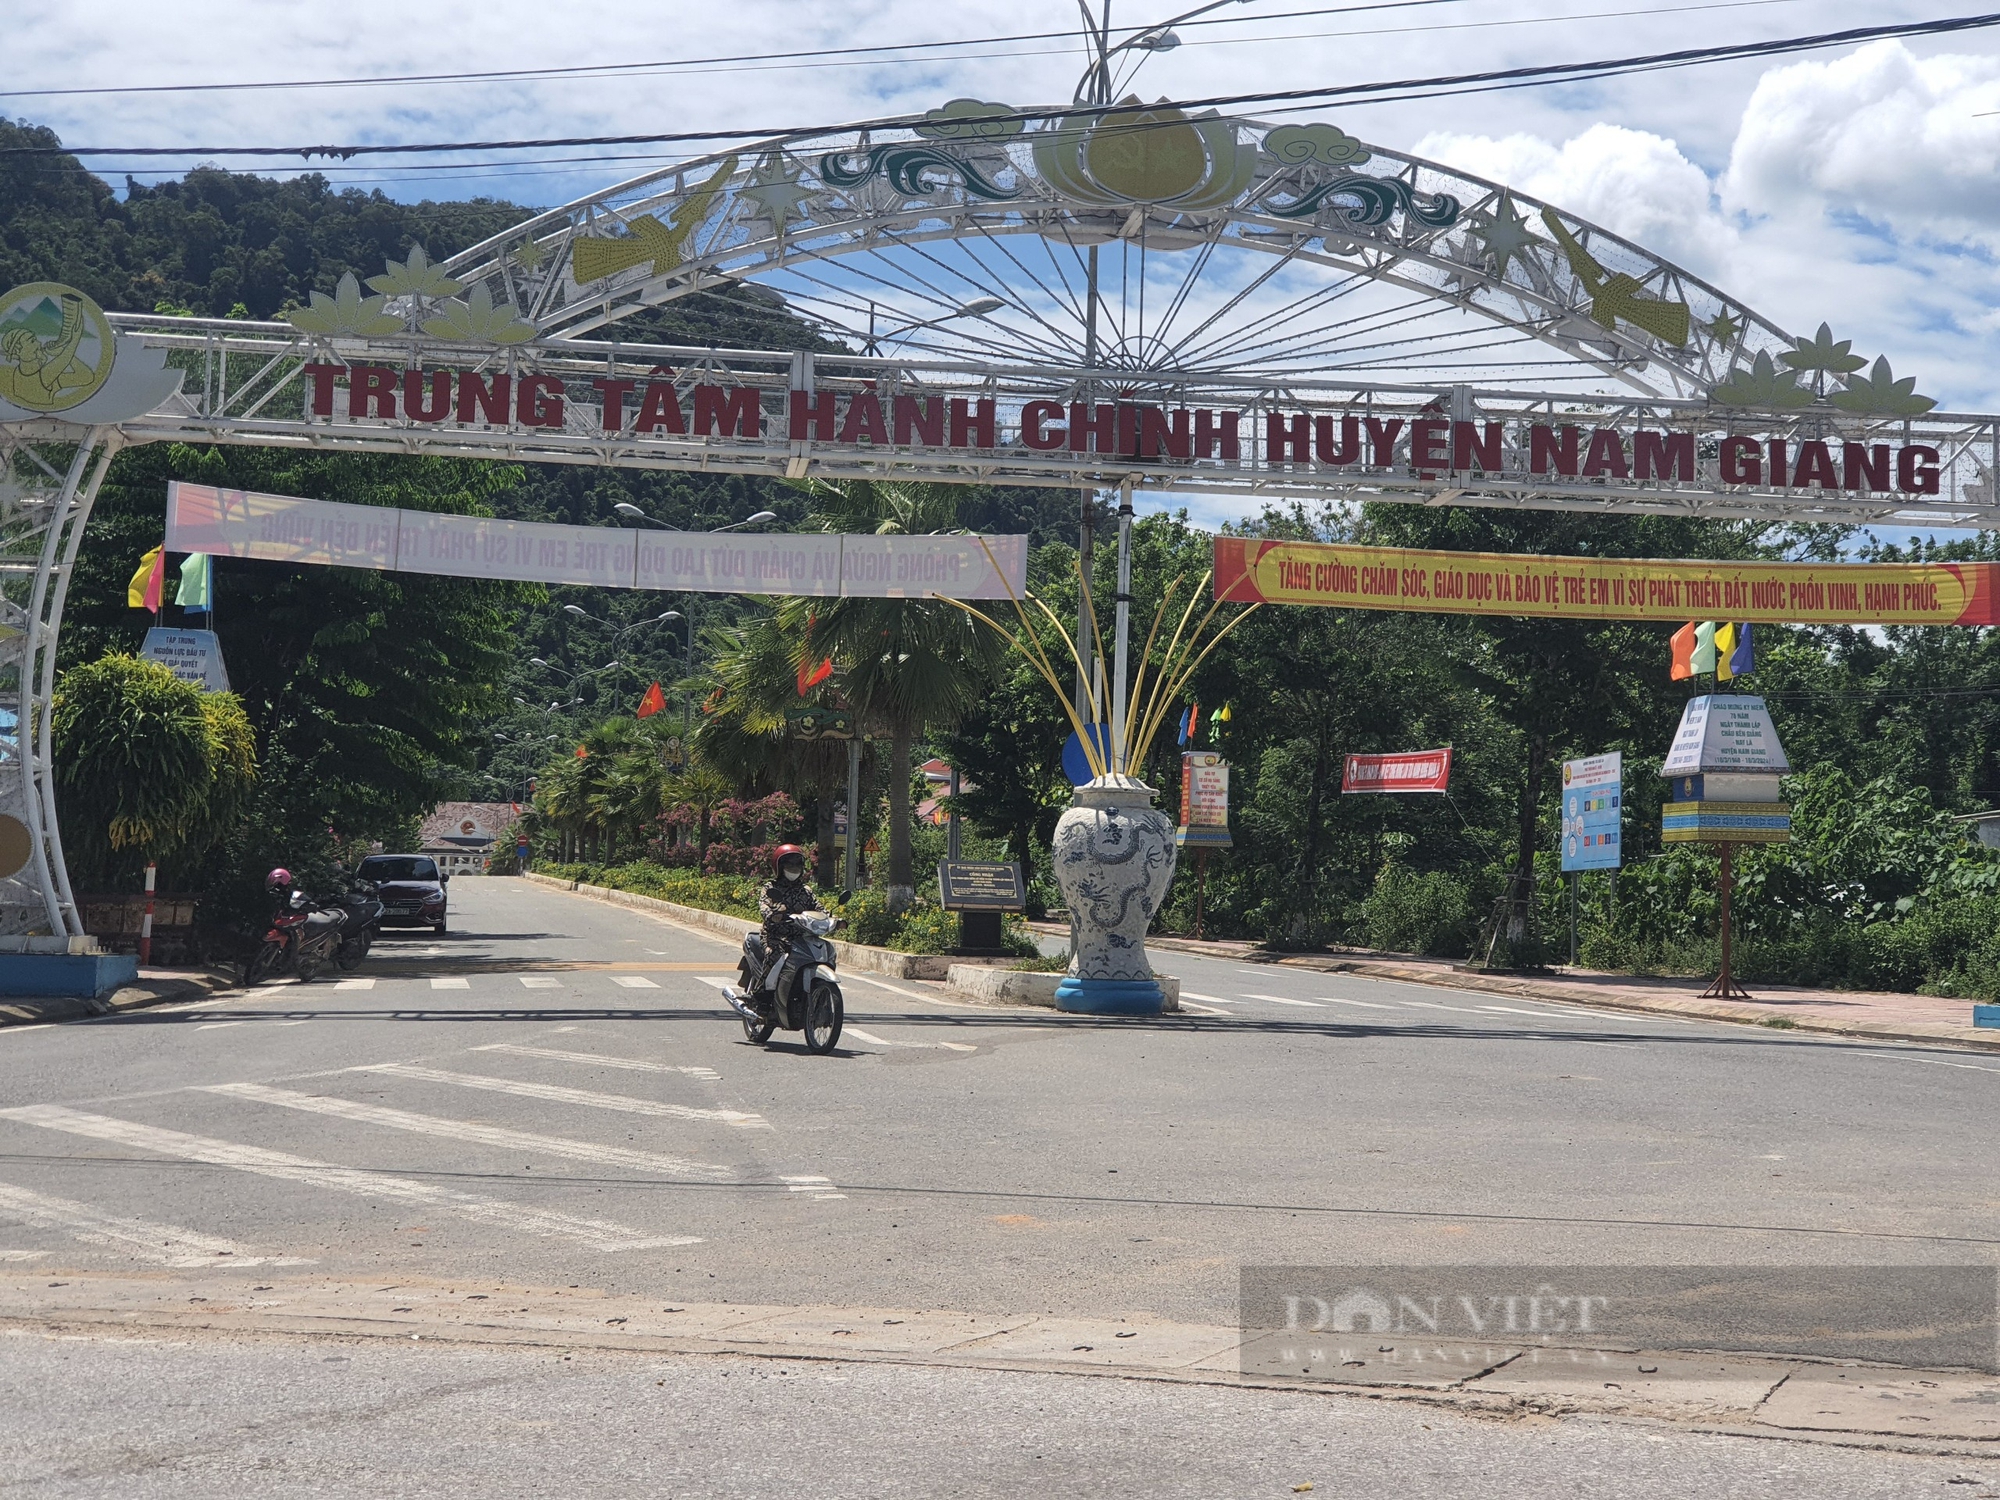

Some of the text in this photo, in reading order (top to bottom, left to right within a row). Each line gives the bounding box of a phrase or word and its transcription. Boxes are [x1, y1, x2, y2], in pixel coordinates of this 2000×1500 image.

[304, 363, 1940, 495] TRUNG TÂM HÀNH CHÍNH HUYỆN NAM GIANG
[1278, 556, 1312, 591] TĂNG
[1315, 557, 1357, 593] CƯỜNG
[1361, 561, 1398, 596] CHĂM
[1402, 562, 1430, 601] SÓC,
[1434, 565, 1463, 600] GIÁO
[1467, 572, 1492, 607] DỤC
[1496, 568, 1511, 602] VÀ
[1515, 565, 1541, 603] BẢO
[1544, 570, 1559, 610] VỆ
[1563, 567, 1586, 605] TRẺ
[1590, 577, 1609, 605] EM
[1613, 572, 1625, 606] VÌ
[1628, 576, 1646, 612] SỰ
[1650, 573, 1681, 608] PHÁT
[1685, 569, 1721, 608] TRIỂN
[1724, 571, 1748, 609] ĐẤT
[1752, 575, 1786, 610] NƯỚC
[1827, 582, 1861, 614] VINH,
[1864, 583, 1900, 617] HẠNH
[1903, 576, 1942, 611] PHÚC.
